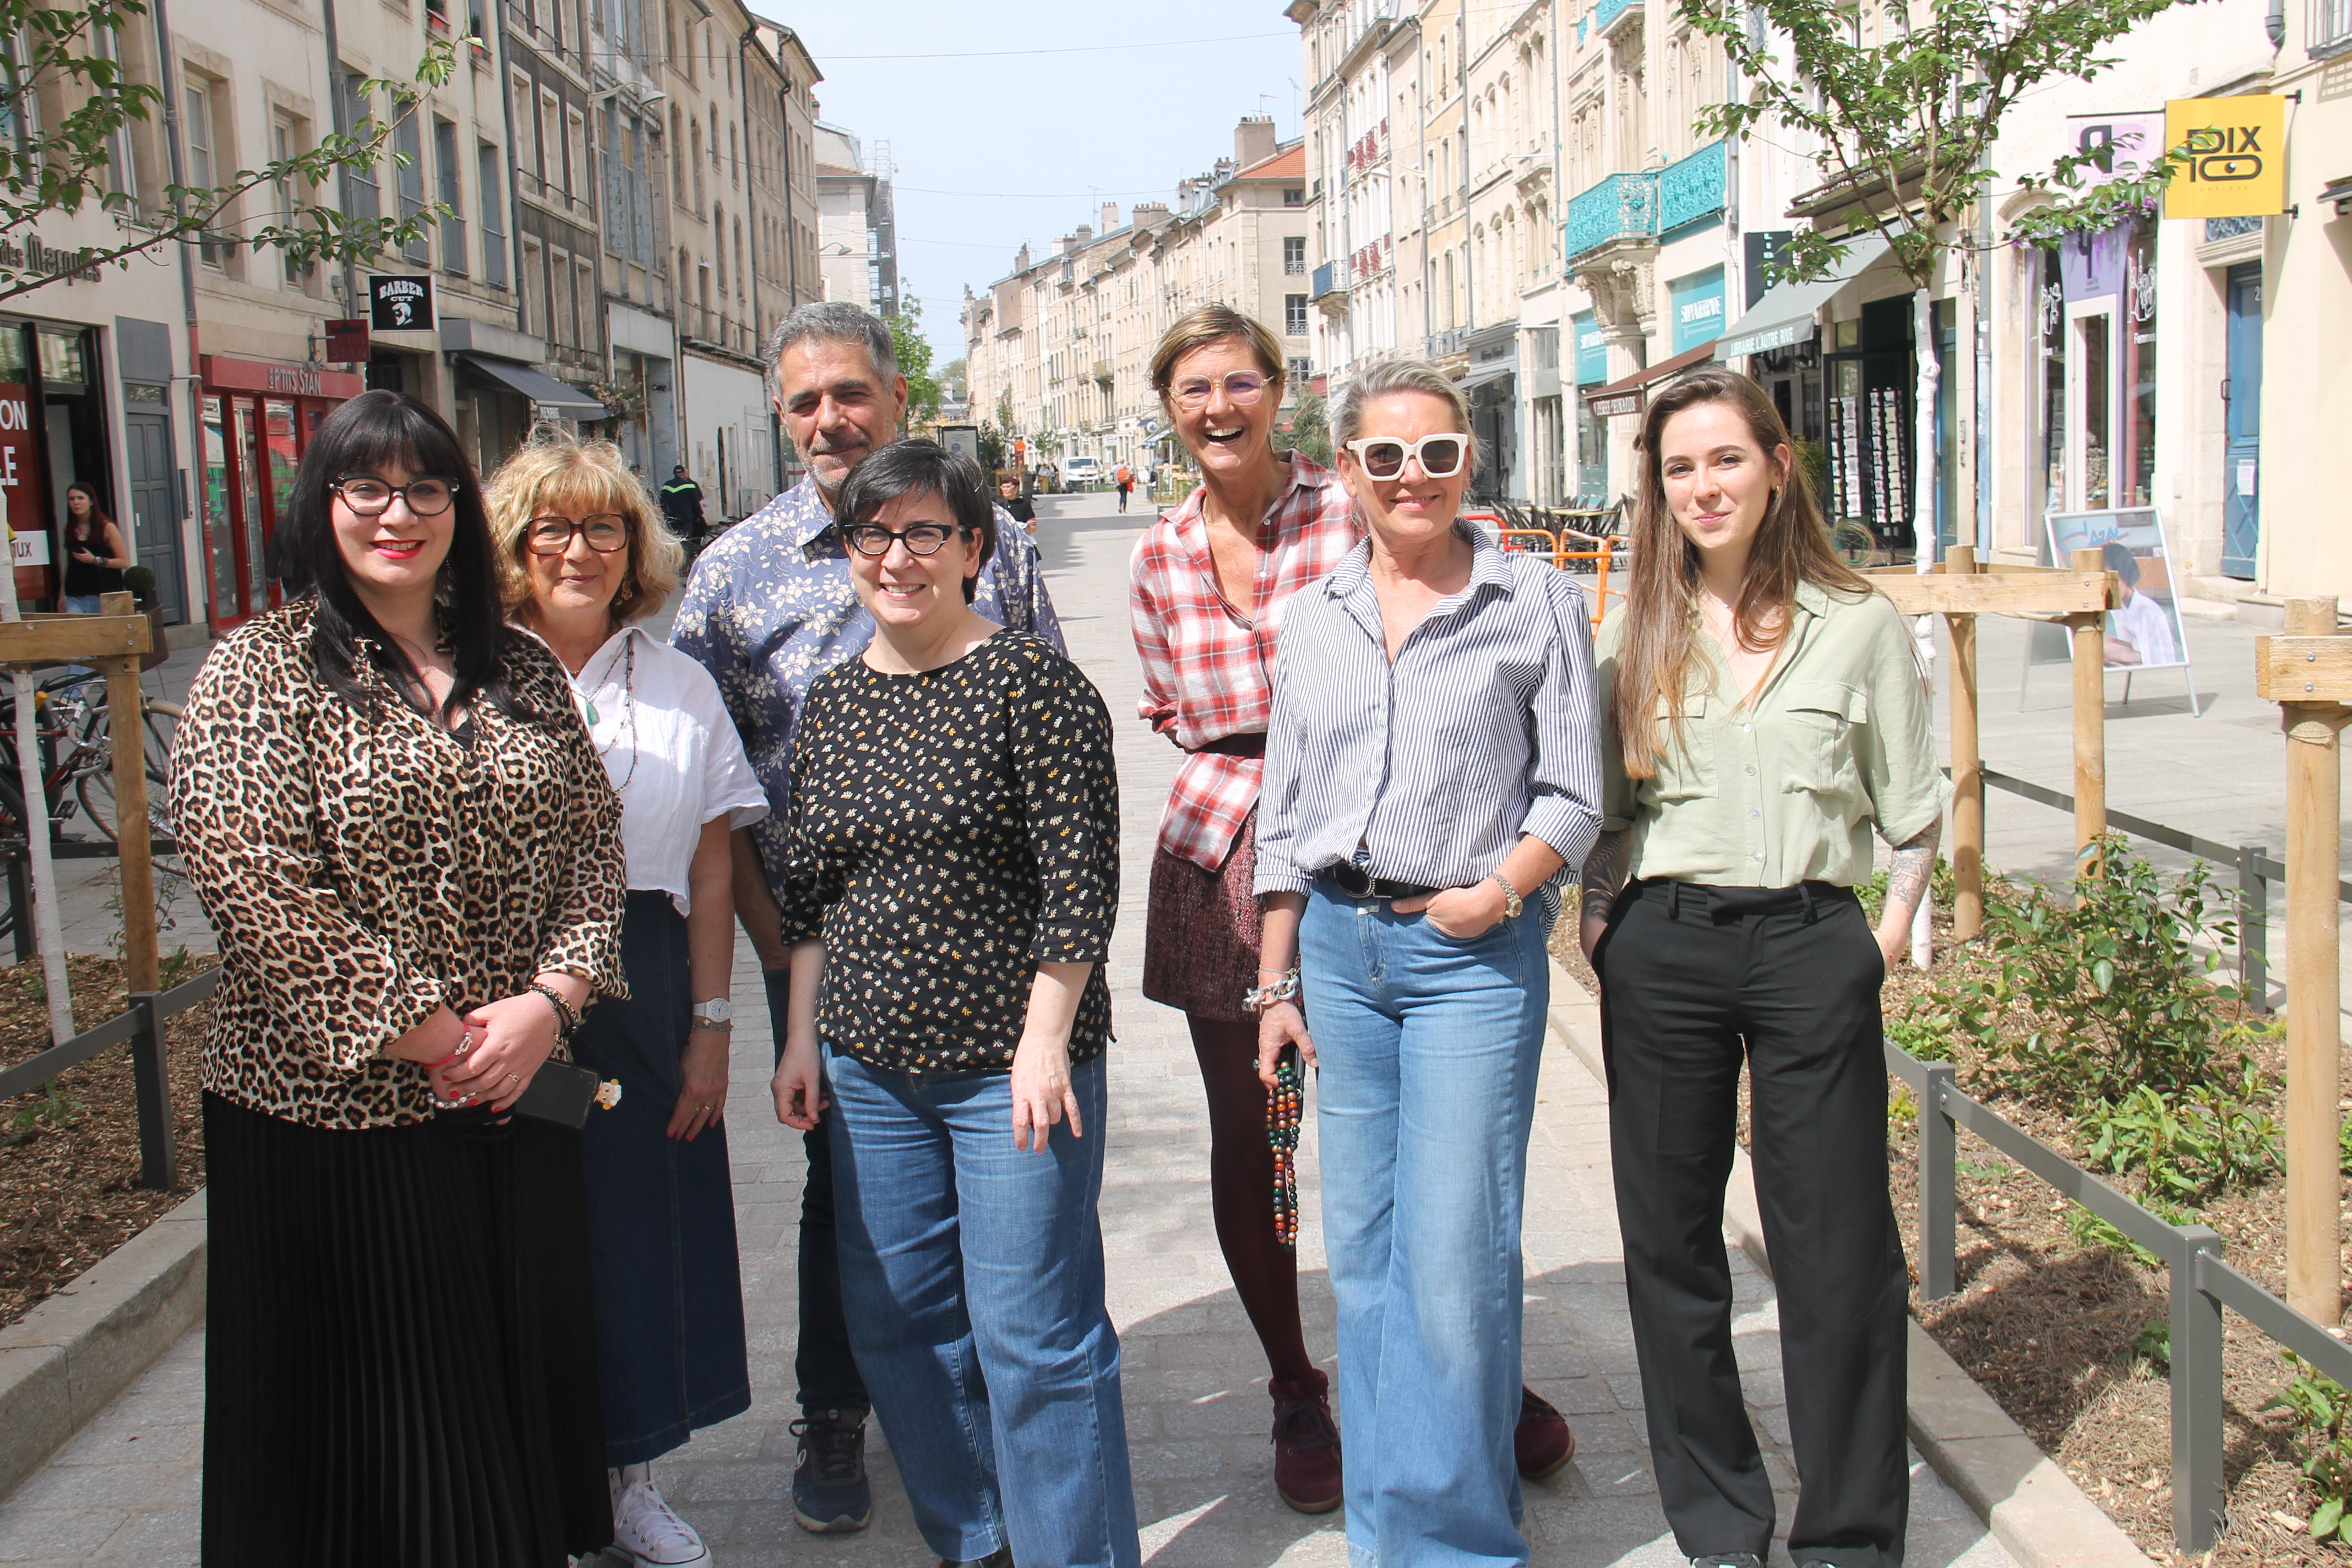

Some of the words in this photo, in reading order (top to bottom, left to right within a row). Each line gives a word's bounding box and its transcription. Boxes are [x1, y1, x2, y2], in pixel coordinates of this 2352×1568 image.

[2186, 126, 2262, 155] DIX
[379, 280, 424, 300] BARBER
[1730, 337, 1755, 357] LIBRAIRIE
[1756, 330, 1778, 350] L'AUTRE
[1779, 327, 1793, 344] RIVE
[2134, 333, 2156, 344] Femmes
[331, 346, 367, 359] STAN
[275, 368, 297, 392] P'TITS
[299, 368, 321, 395] STAN
[2057, 520, 2130, 558] CAZAL
